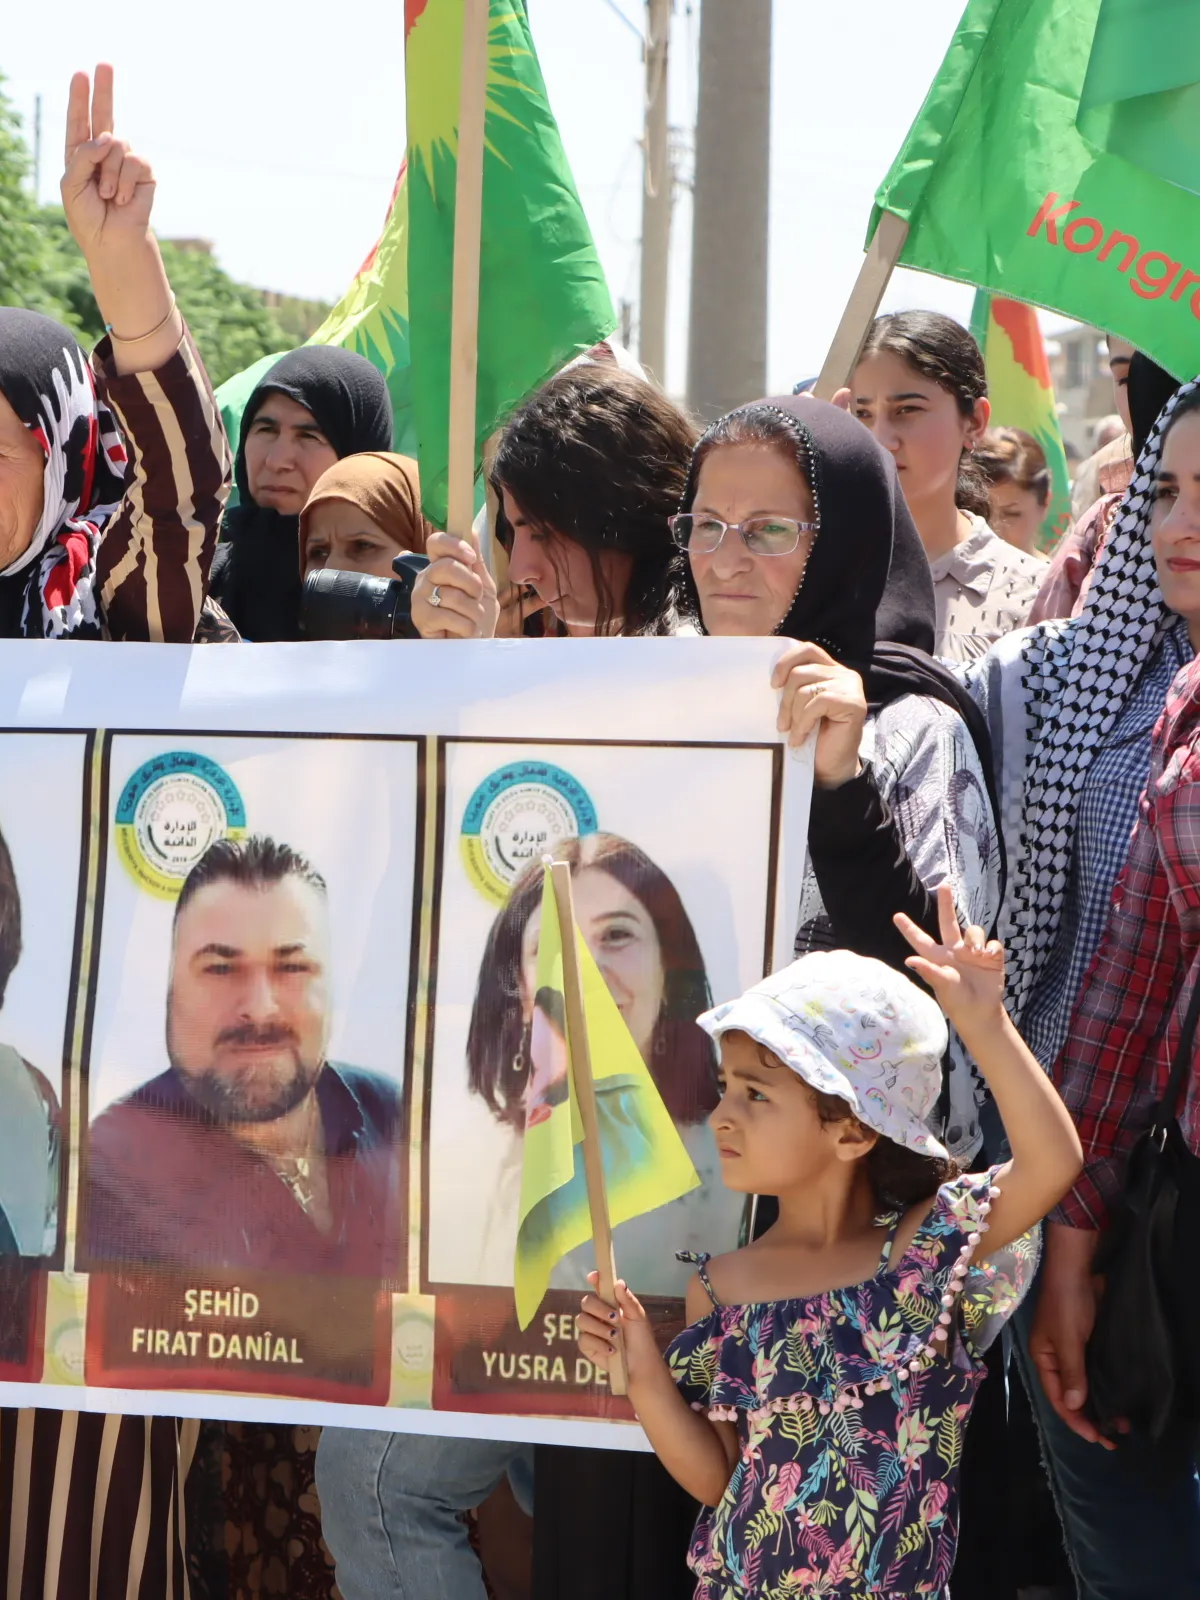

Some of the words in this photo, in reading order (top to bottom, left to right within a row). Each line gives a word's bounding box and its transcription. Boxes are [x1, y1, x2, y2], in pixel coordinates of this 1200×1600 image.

[184, 1286, 259, 1321] ŞEHÎD
[131, 1328, 202, 1357] FIRAT
[207, 1331, 304, 1364] DANÎAL
[482, 1351, 567, 1383] YUSRA
[575, 1357, 608, 1385] DE
